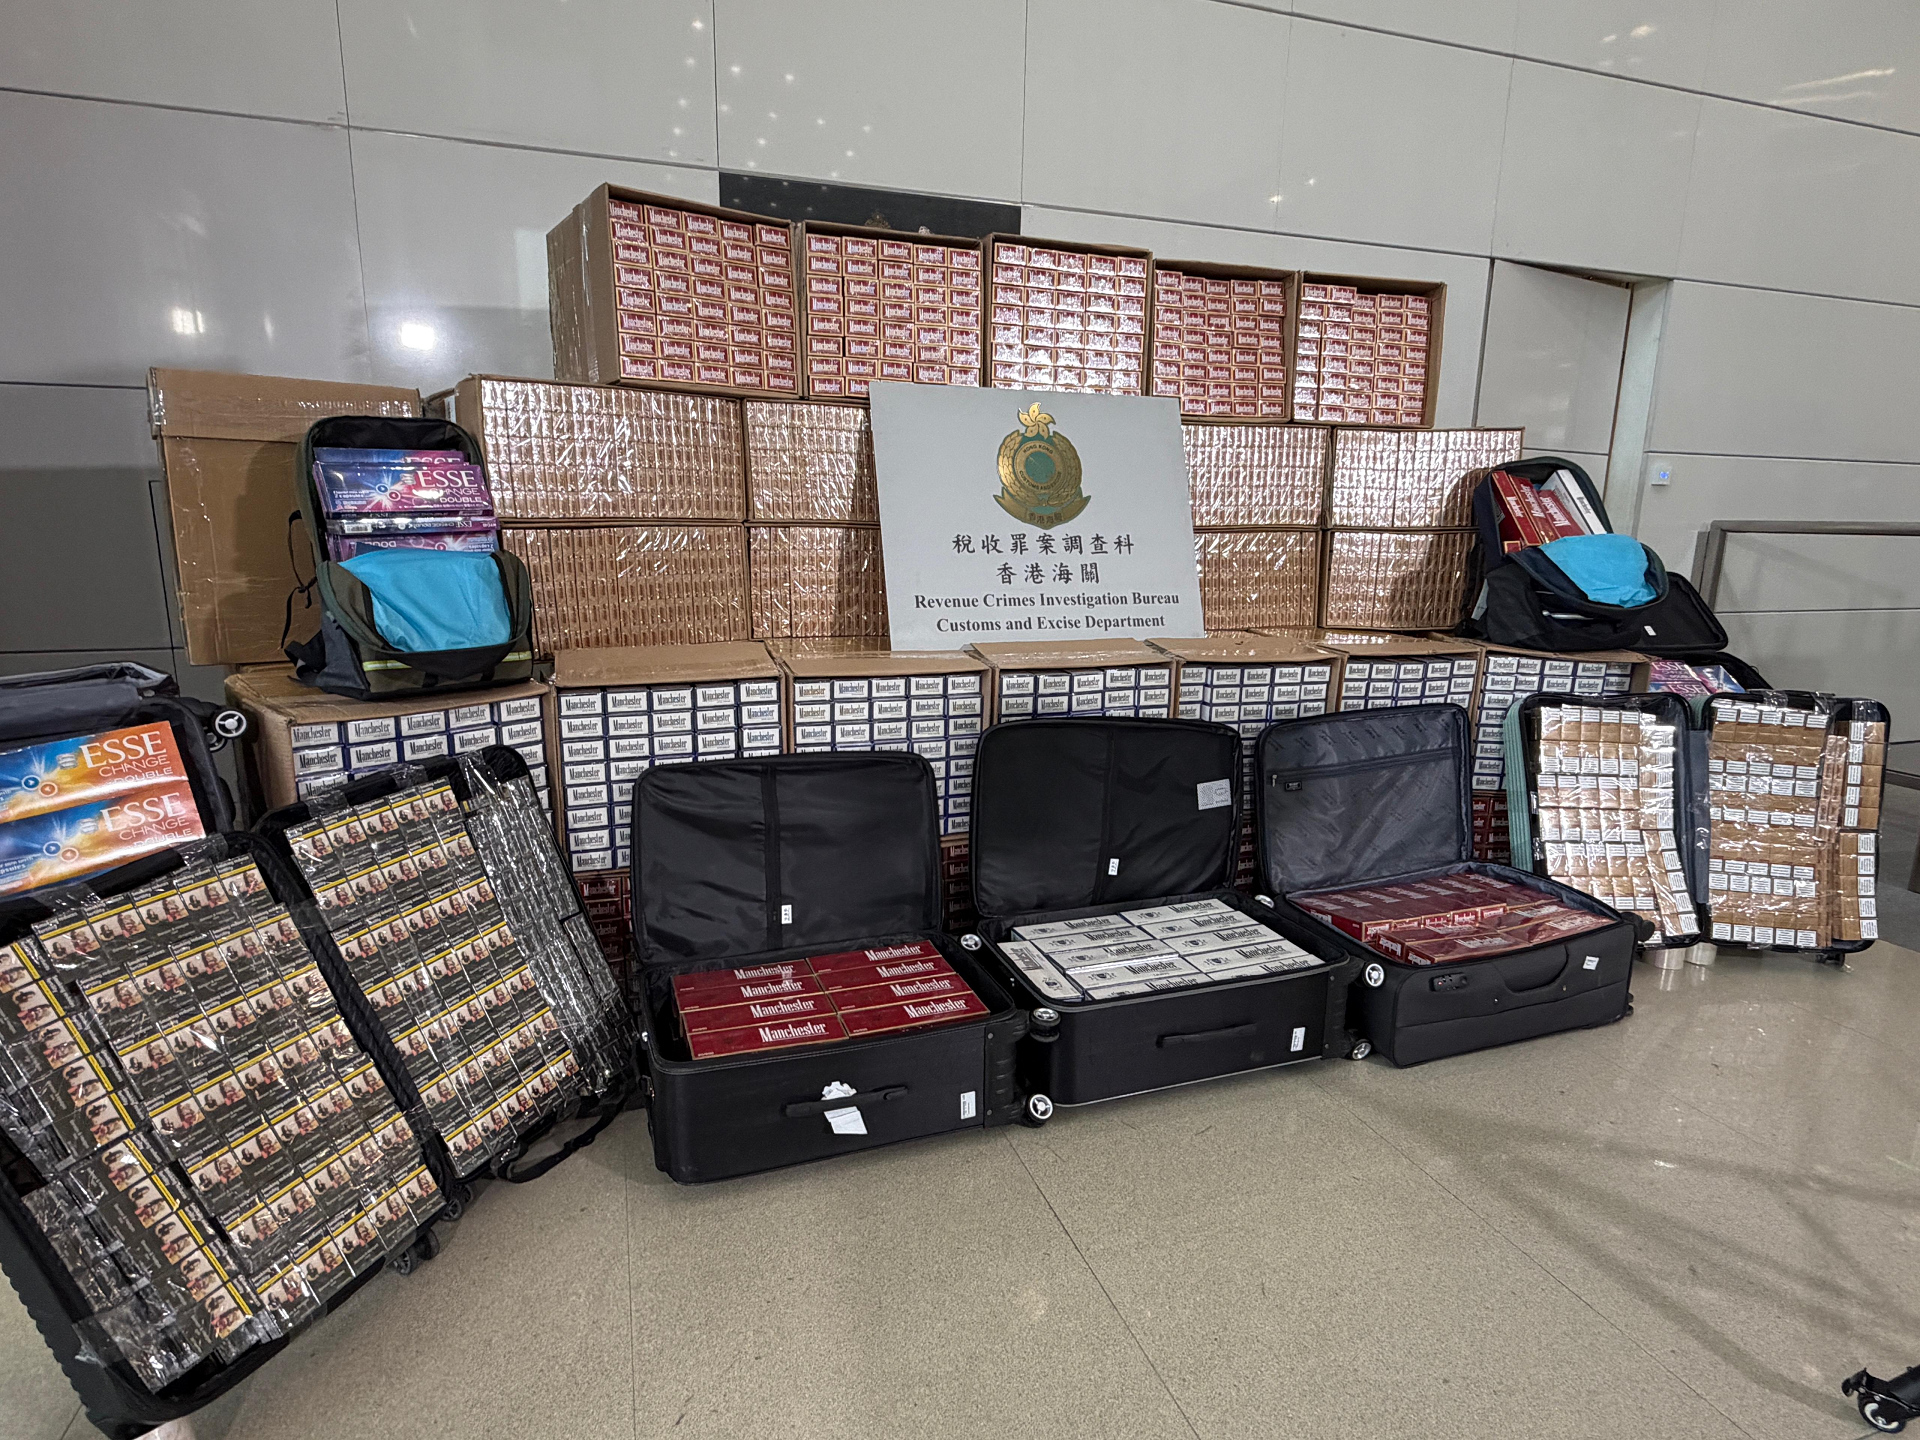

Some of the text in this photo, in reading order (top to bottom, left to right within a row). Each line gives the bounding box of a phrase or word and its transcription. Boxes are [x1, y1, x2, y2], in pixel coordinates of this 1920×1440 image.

[1022, 444, 1054, 454] HONG KONG
[416, 470, 478, 487] ESSE
[1521, 484, 1546, 518] Manchester
[1540, 496, 1571, 526] Manchester
[996, 562, 1100, 585] 香港海關
[914, 592, 1180, 609] Revenue Crimes Investigation Bureau
[936, 615, 1166, 632] Customs and Excise Department
[1651, 662, 1685, 670] ESSE
[952, 676, 975, 688] Manchester
[1077, 676, 1099, 688] Manchester
[1110, 672, 1132, 683] Manchester
[1145, 670, 1166, 681] Manchester
[839, 682, 864, 694] Manchester
[876, 681, 900, 693] Manchester
[916, 679, 940, 690] Manchester
[1006, 679, 1029, 690] Manchester
[1044, 677, 1066, 689] Manchester
[1668, 685, 1702, 693] ESSE
[702, 690, 730, 702] Manchester
[745, 685, 773, 697] Manchester
[799, 685, 825, 697] Manchester
[1108, 692, 1130, 703] Manchester
[1144, 690, 1165, 701] Manchester
[566, 699, 596, 712] Manchester
[612, 696, 641, 708] Manchester
[657, 694, 687, 706] Manchester
[916, 701, 940, 712] Manchester
[953, 700, 976, 711] Manchester
[1005, 699, 1029, 710] Manchester
[1041, 699, 1064, 710] Manchester
[1077, 695, 1098, 707] Manchester
[454, 706, 485, 722] Manchester
[506, 700, 536, 715] Manchester
[747, 707, 774, 719] Manchester
[800, 707, 826, 718] Manchester
[840, 704, 865, 715] Manchester
[879, 702, 903, 714] Manchester
[407, 716, 440, 731] Manchester
[657, 715, 686, 728] Manchester
[702, 711, 730, 724] Manchester
[355, 722, 390, 737] Manchester
[567, 720, 597, 733] Manchester
[613, 718, 643, 731] Manchester
[877, 724, 902, 736] Manchester
[916, 723, 940, 734] Manchester
[954, 719, 977, 730] Manchester
[293, 725, 331, 742] Manchester
[508, 724, 537, 739] Manchester
[747, 730, 775, 743] Manchester
[801, 727, 827, 739] Manchester
[840, 726, 866, 738] Manchester
[459, 733, 490, 748] Manchester
[615, 740, 644, 753] Manchester
[658, 738, 687, 751] Manchester
[702, 735, 730, 748] Manchester
[954, 740, 976, 751] Mancheste
[79, 731, 167, 769] ESSE
[410, 740, 443, 755] Manchester
[568, 744, 598, 757] Manchester
[918, 743, 943, 754] Manchester
[300, 752, 337, 769] Manchester
[356, 747, 390, 763] Manchester
[99, 754, 171, 778] CHANGE
[955, 760, 973, 772] Manches
[113, 767, 173, 783] DOUBLE
[570, 767, 600, 780] Manchester
[573, 788, 603, 801] Manchester
[100, 792, 187, 832] ESSE
[572, 811, 602, 824] Manchester
[119, 816, 190, 841] CHANGE
[952, 817, 969, 829] Manches
[574, 833, 604, 847] Manchester
[577, 854, 606, 867] Manchester
[584, 882, 615, 896] Manchester
[1169, 901, 1212, 913] Manchester
[1064, 917, 1111, 929] Manchester
[1190, 913, 1235, 928] Manchester
[1084, 928, 1131, 941] Manchester
[1213, 927, 1261, 942] Manchester
[865, 944, 921, 961] Manchester
[1103, 942, 1154, 958] Manchester
[1236, 943, 1284, 959] Manchester
[734, 964, 794, 980] Manchester
[876, 960, 935, 978] Manchester
[1125, 958, 1177, 975] Manchester
[740, 980, 803, 998] Manchester
[890, 978, 951, 997] Manchester
[750, 998, 815, 1018] Manchester
[903, 998, 966, 1018] Manchester
[758, 1022, 826, 1042] Manchester
